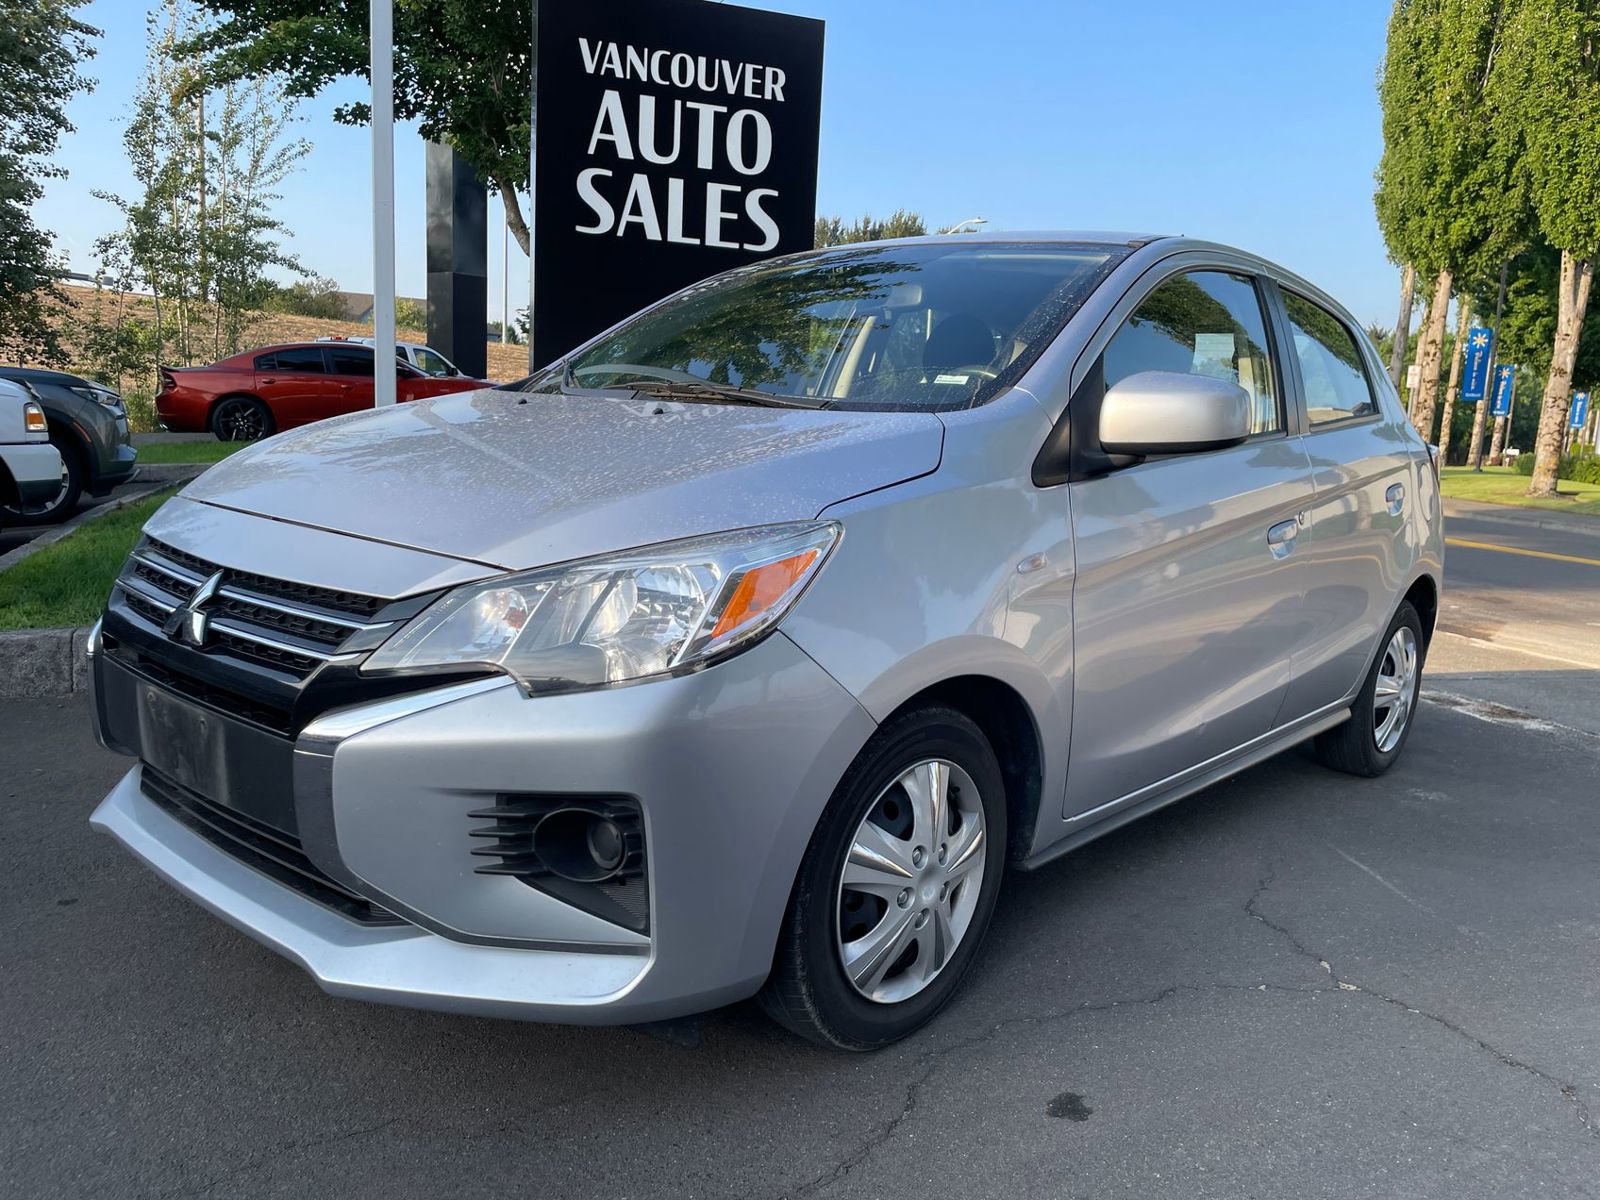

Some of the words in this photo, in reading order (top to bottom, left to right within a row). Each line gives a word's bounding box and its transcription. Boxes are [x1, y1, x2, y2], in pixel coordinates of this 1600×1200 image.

[578, 37, 786, 102] VANCOUVER
[587, 89, 772, 175] AUTO
[575, 167, 780, 251] SALES
